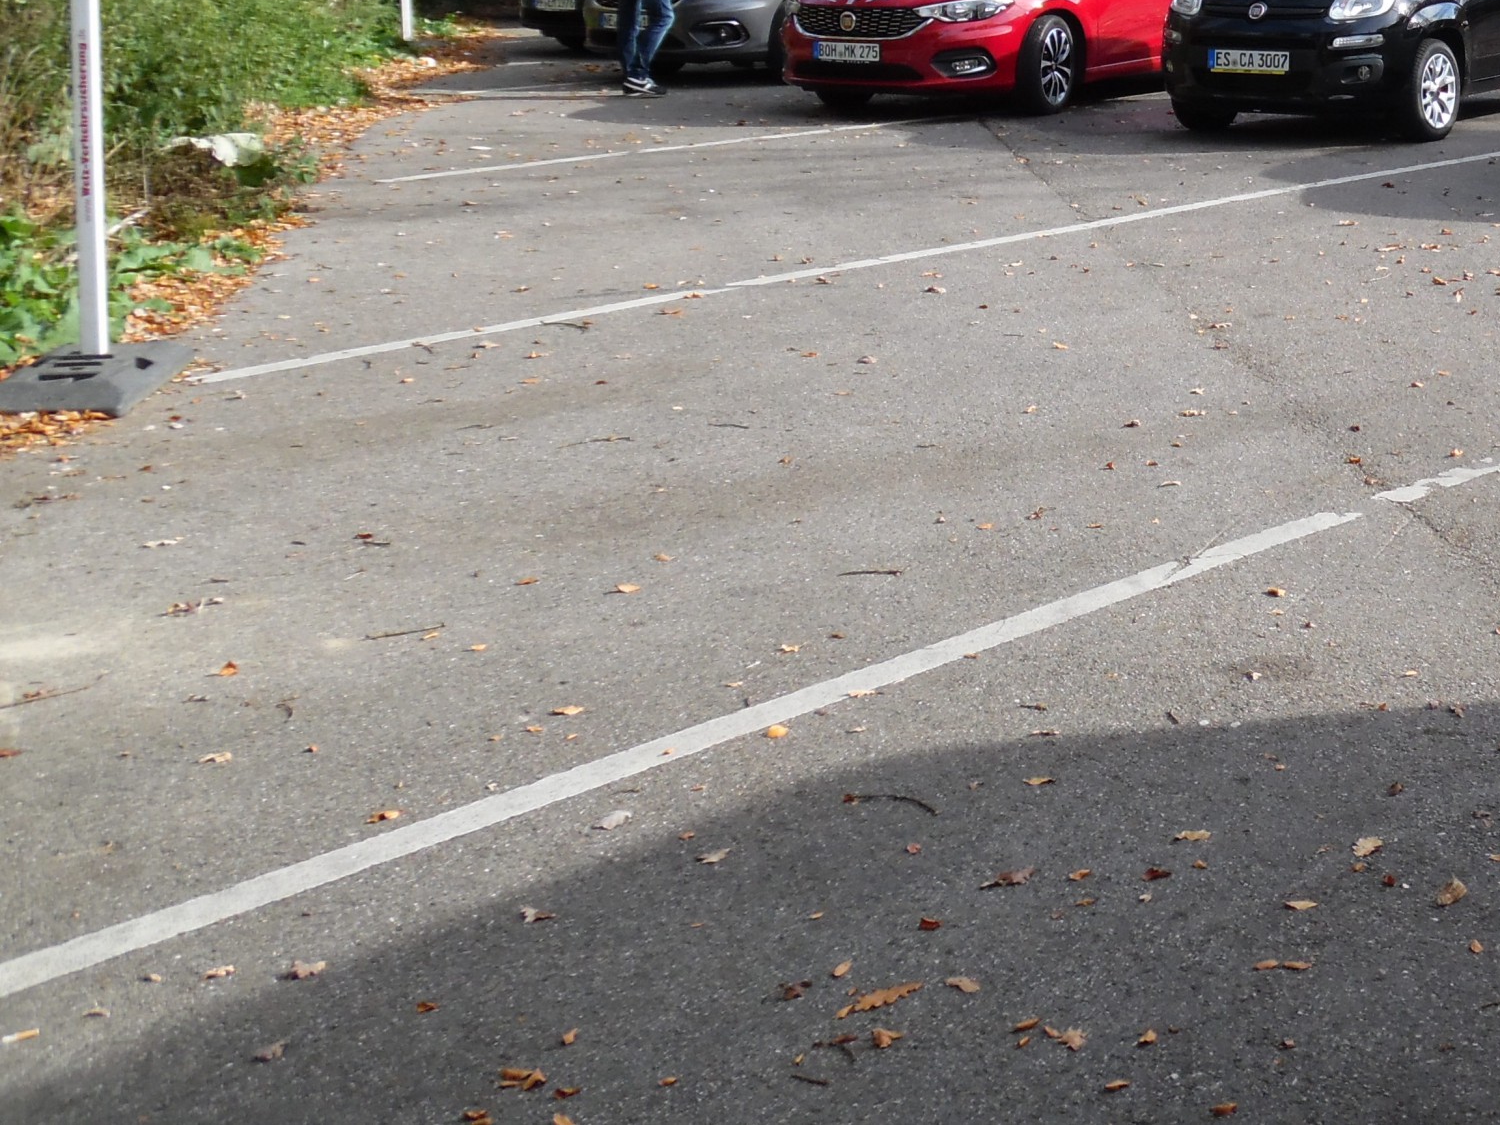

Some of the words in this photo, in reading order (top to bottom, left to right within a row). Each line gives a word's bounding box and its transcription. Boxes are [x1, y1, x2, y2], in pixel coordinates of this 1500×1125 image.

[818, 43, 837, 57] BOH
[843, 46, 857, 58] MK
[859, 45, 879, 59] 275
[1215, 51, 1231, 67] ES
[1239, 52, 1254, 68] CA
[1258, 53, 1288, 68] 3007
